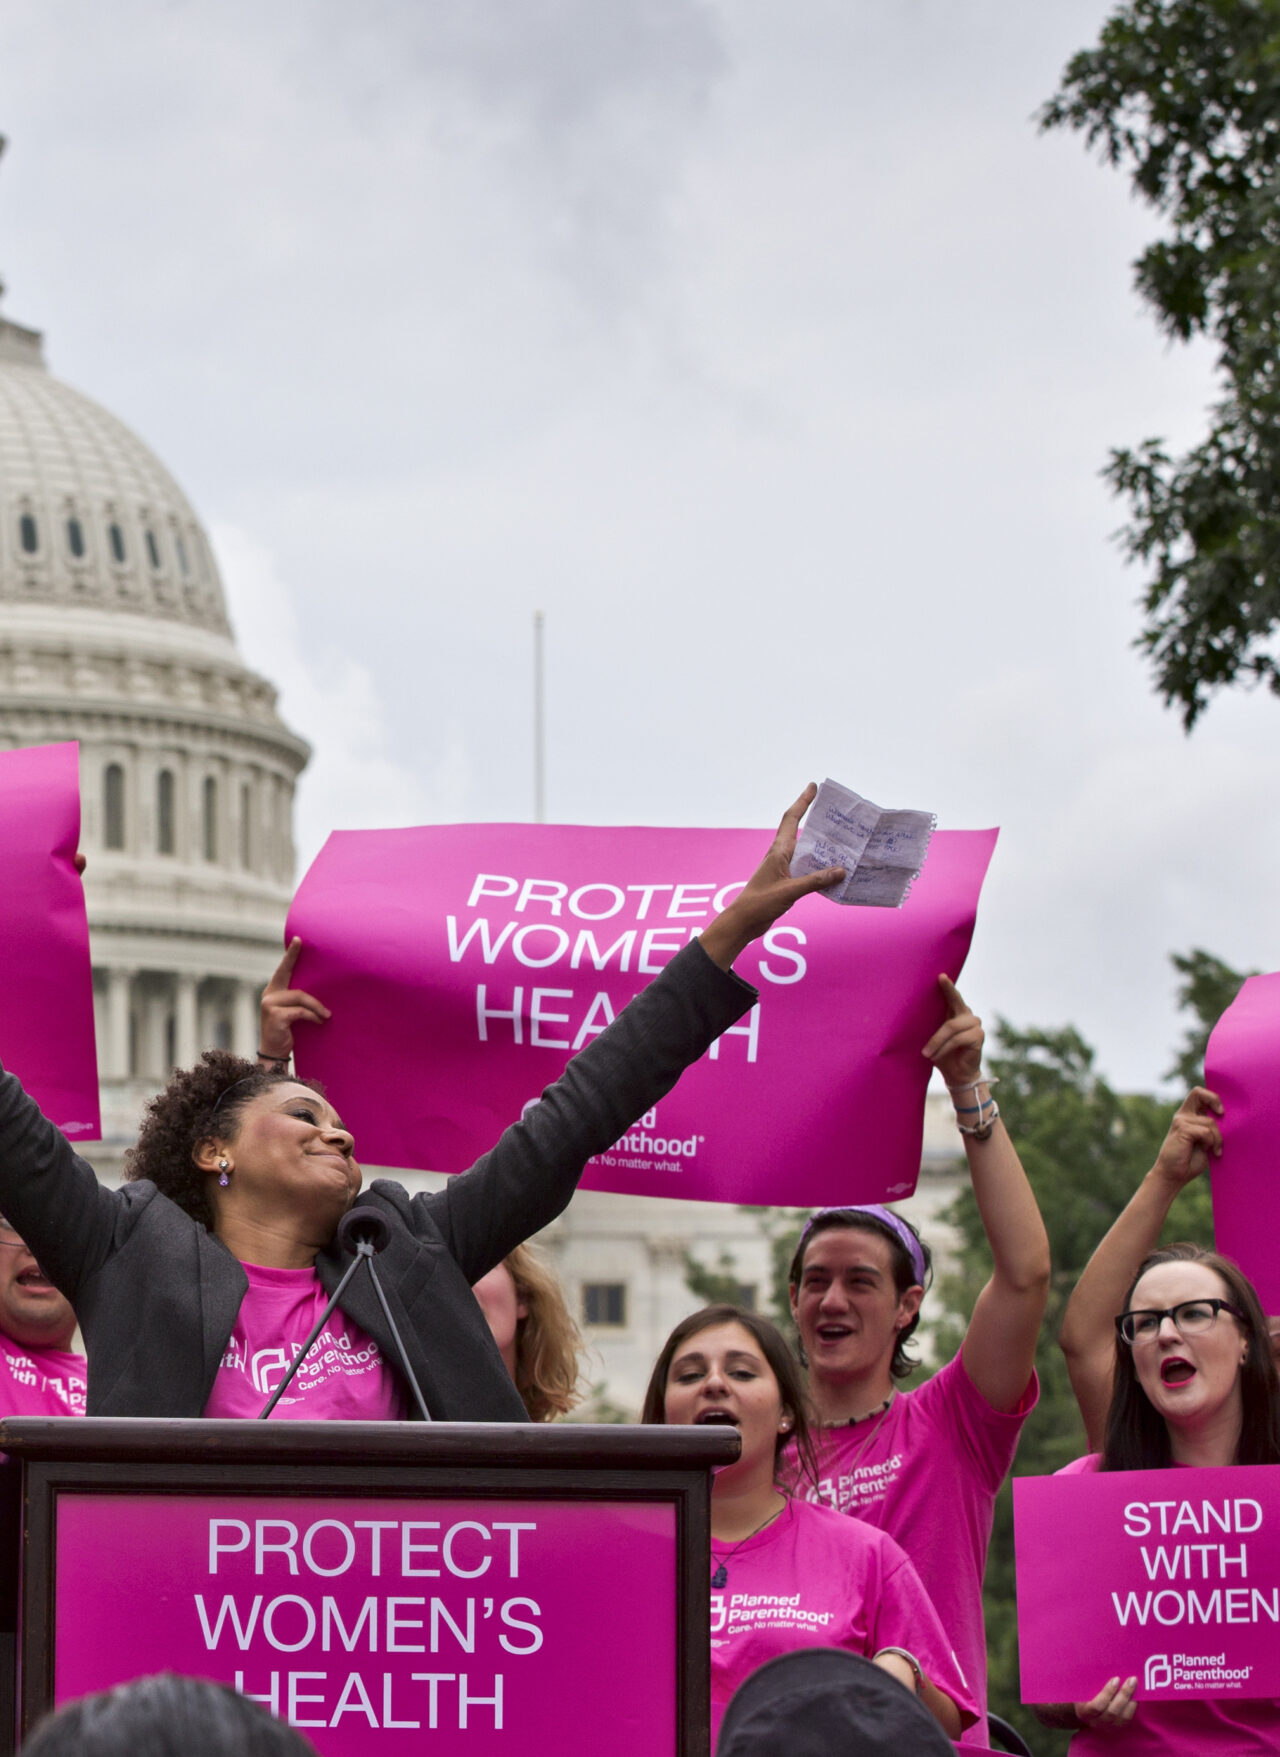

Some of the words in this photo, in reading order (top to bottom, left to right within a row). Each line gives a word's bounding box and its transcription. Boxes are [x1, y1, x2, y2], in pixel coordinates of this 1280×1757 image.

[467, 874, 750, 921] PROTEC
[446, 915, 807, 985] WOMES
[475, 983, 761, 1063] HEAH
[600, 1155, 617, 1167] No
[618, 1157, 653, 1170] matter
[654, 1159, 683, 1172] what.
[9, 1366, 37, 1386] ith
[219, 1353, 245, 1373] ith
[298, 1375, 328, 1391] Care.
[327, 1365, 341, 1377] No
[1123, 1498, 1263, 1537] STAND
[208, 1518, 537, 1578] PROTECT
[1140, 1543, 1247, 1580] WITH
[730, 1593, 800, 1607] Planned
[1111, 1588, 1280, 1626] WOMEN
[194, 1594, 544, 1656] WOMEN'S
[727, 1624, 752, 1634] Care.
[754, 1621, 766, 1629] No
[767, 1620, 795, 1629] matter
[796, 1622, 818, 1632] what.
[1173, 1652, 1225, 1667] Planned
[235, 1670, 504, 1730] HEALTH
